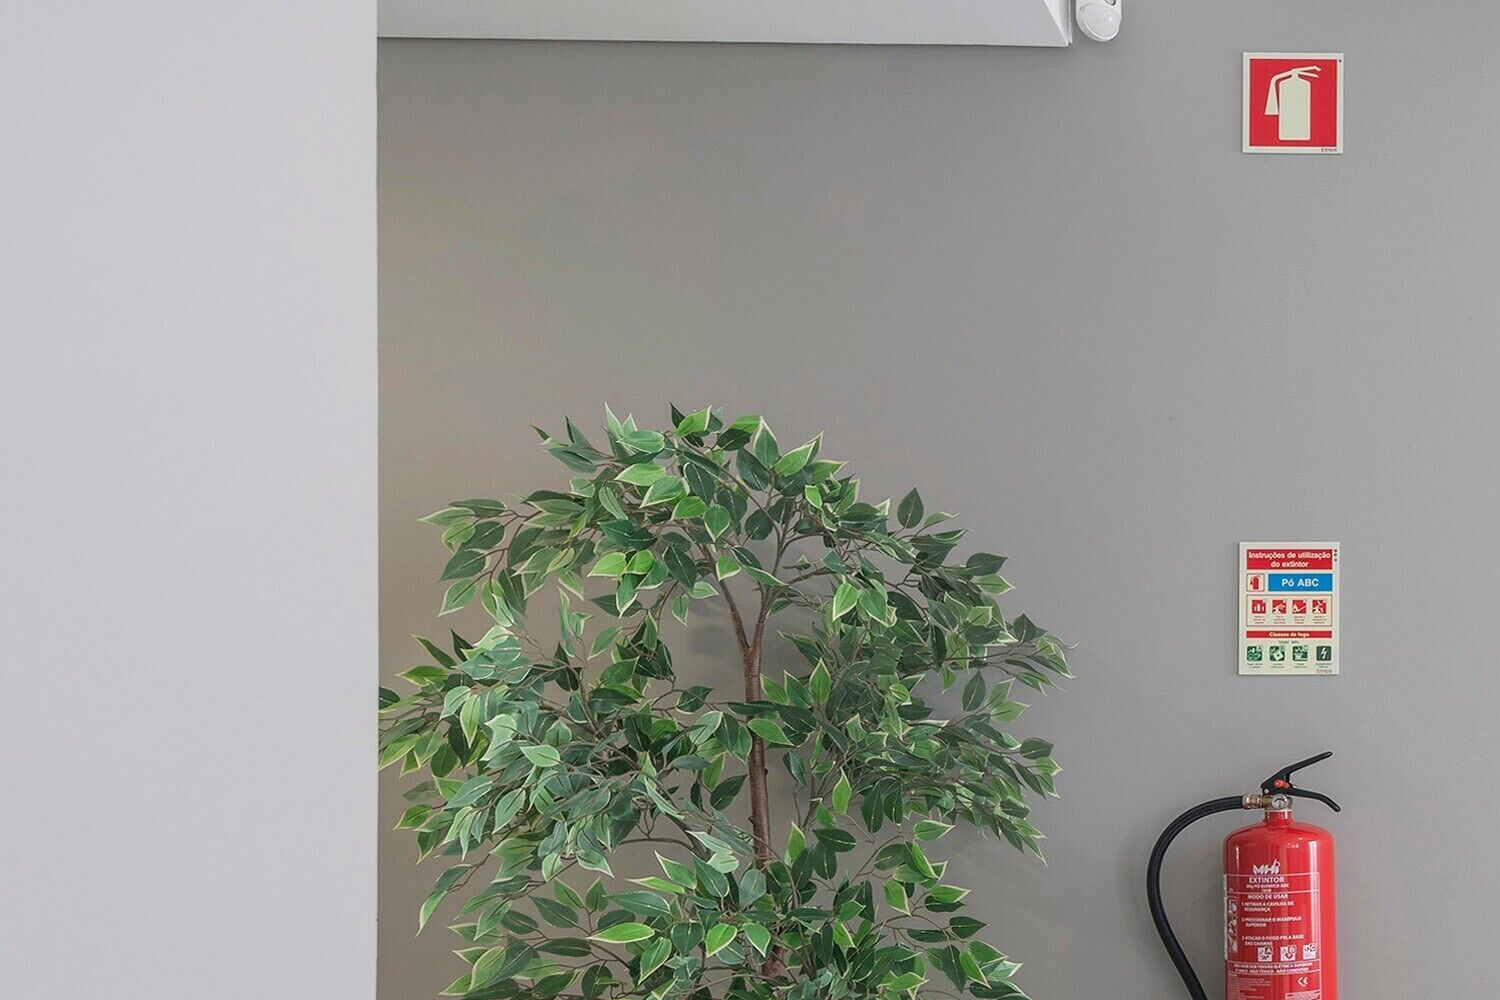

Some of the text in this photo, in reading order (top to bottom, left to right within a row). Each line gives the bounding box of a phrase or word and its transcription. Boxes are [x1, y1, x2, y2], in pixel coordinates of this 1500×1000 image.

[1248, 551, 1286, 560] Instruções
[1298, 551, 1332, 560] utilização
[1281, 578, 1320, 587] Pó ABC
[1298, 631, 1310, 639] fogo
[1248, 876, 1285, 884] EXTINTOR
